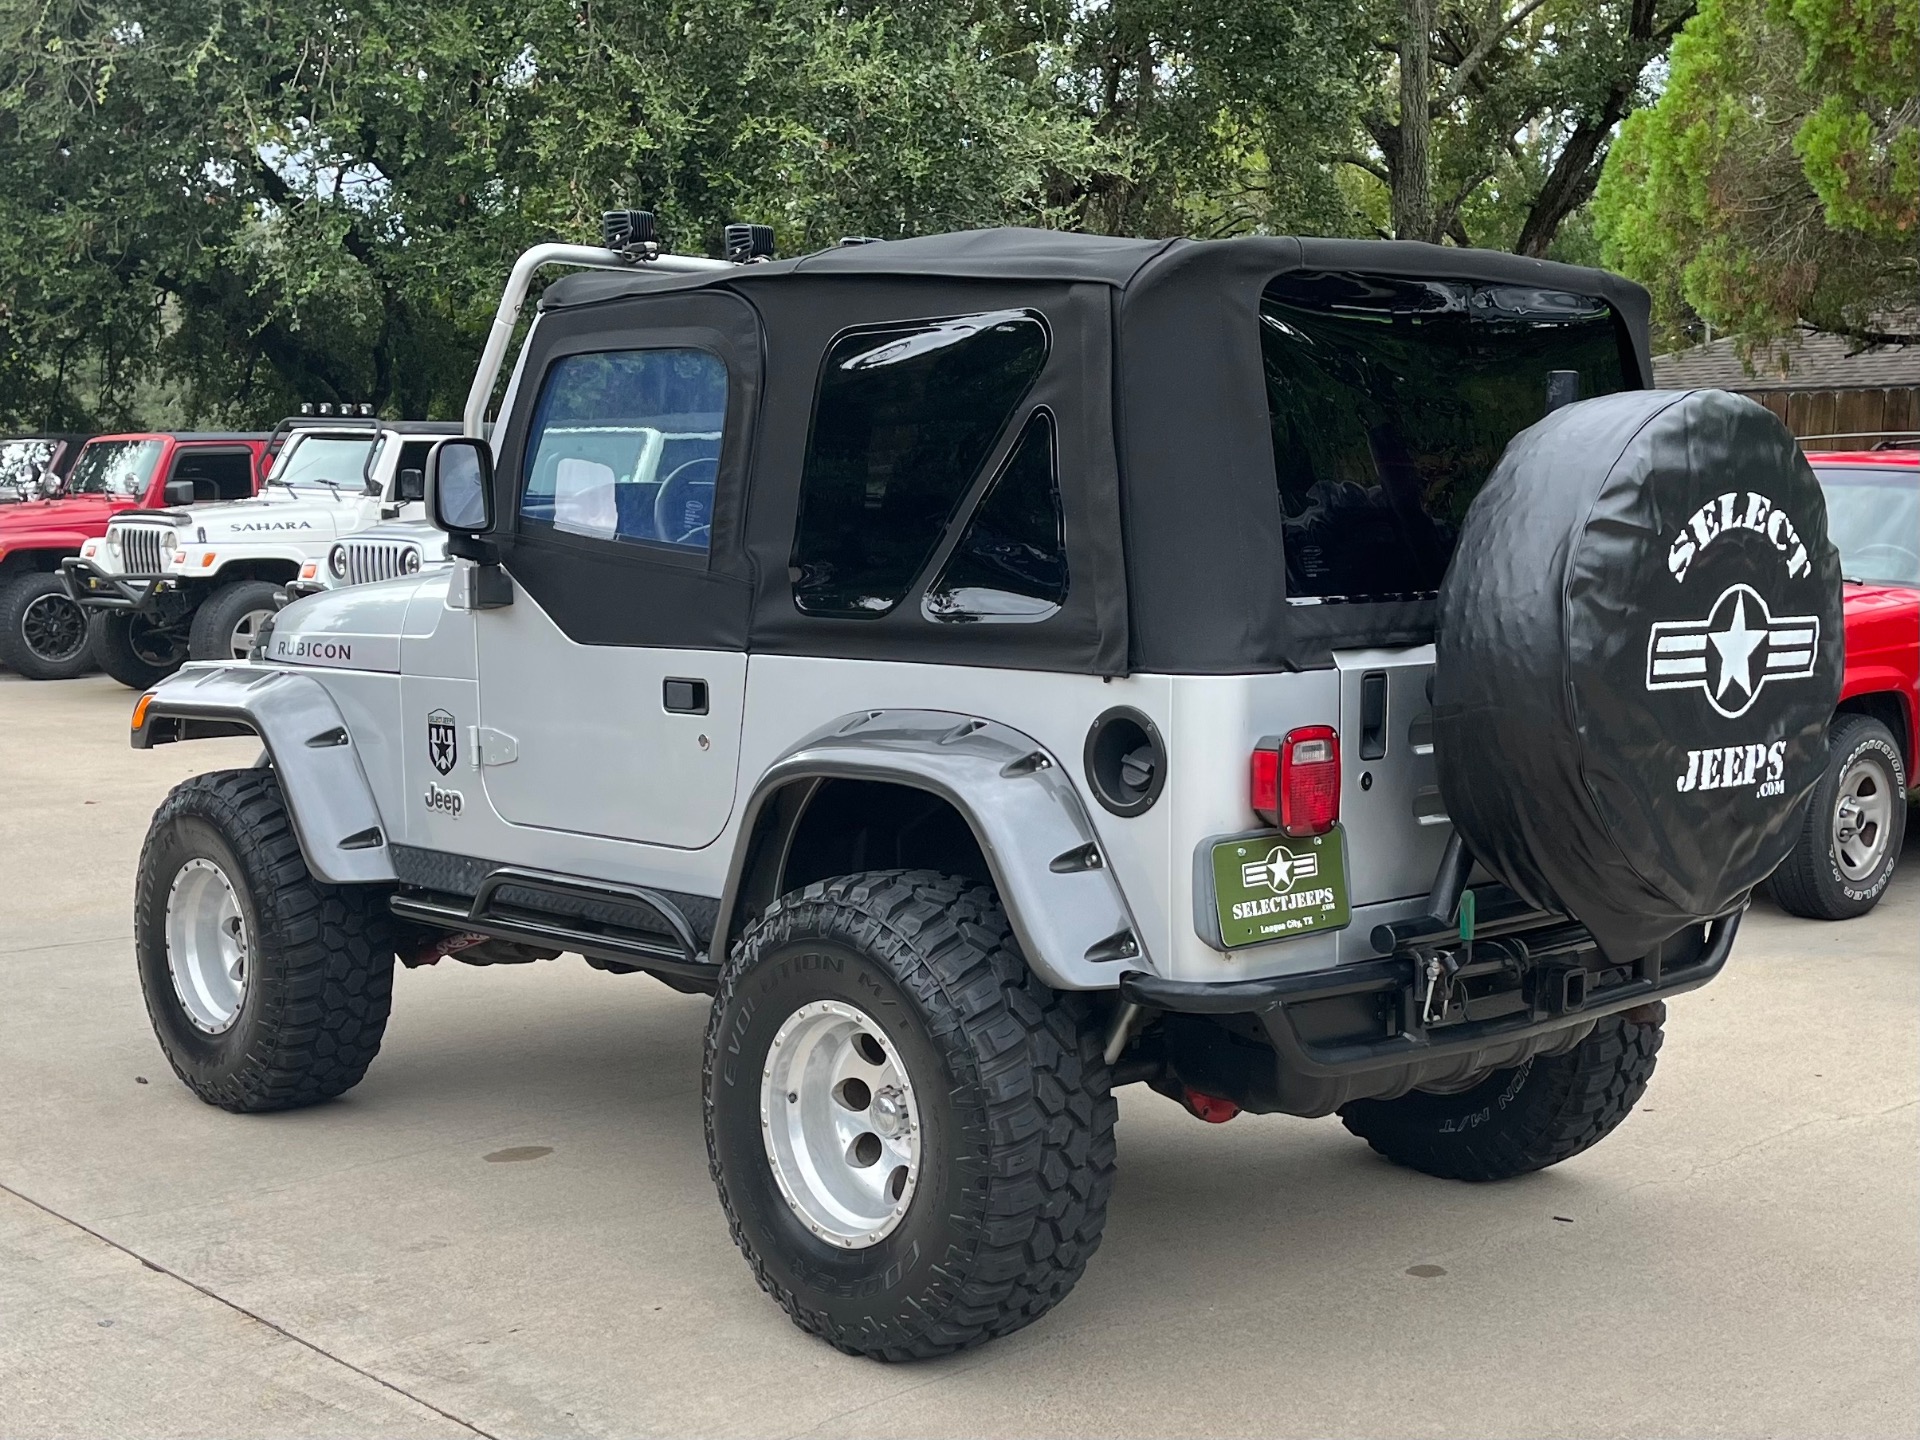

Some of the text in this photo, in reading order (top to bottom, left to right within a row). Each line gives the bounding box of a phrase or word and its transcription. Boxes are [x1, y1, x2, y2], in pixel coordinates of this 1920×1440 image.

[230, 521, 312, 532] SAHARA
[1668, 491, 1811, 583] SELECT
[278, 641, 351, 660] RUBICON
[1676, 741, 1787, 792] JEEPS
[425, 783, 464, 819] Jeep
[1756, 780, 1785, 799] .COM
[1232, 888, 1334, 919] SELECTJEEPS
[1303, 916, 1314, 926] TX
